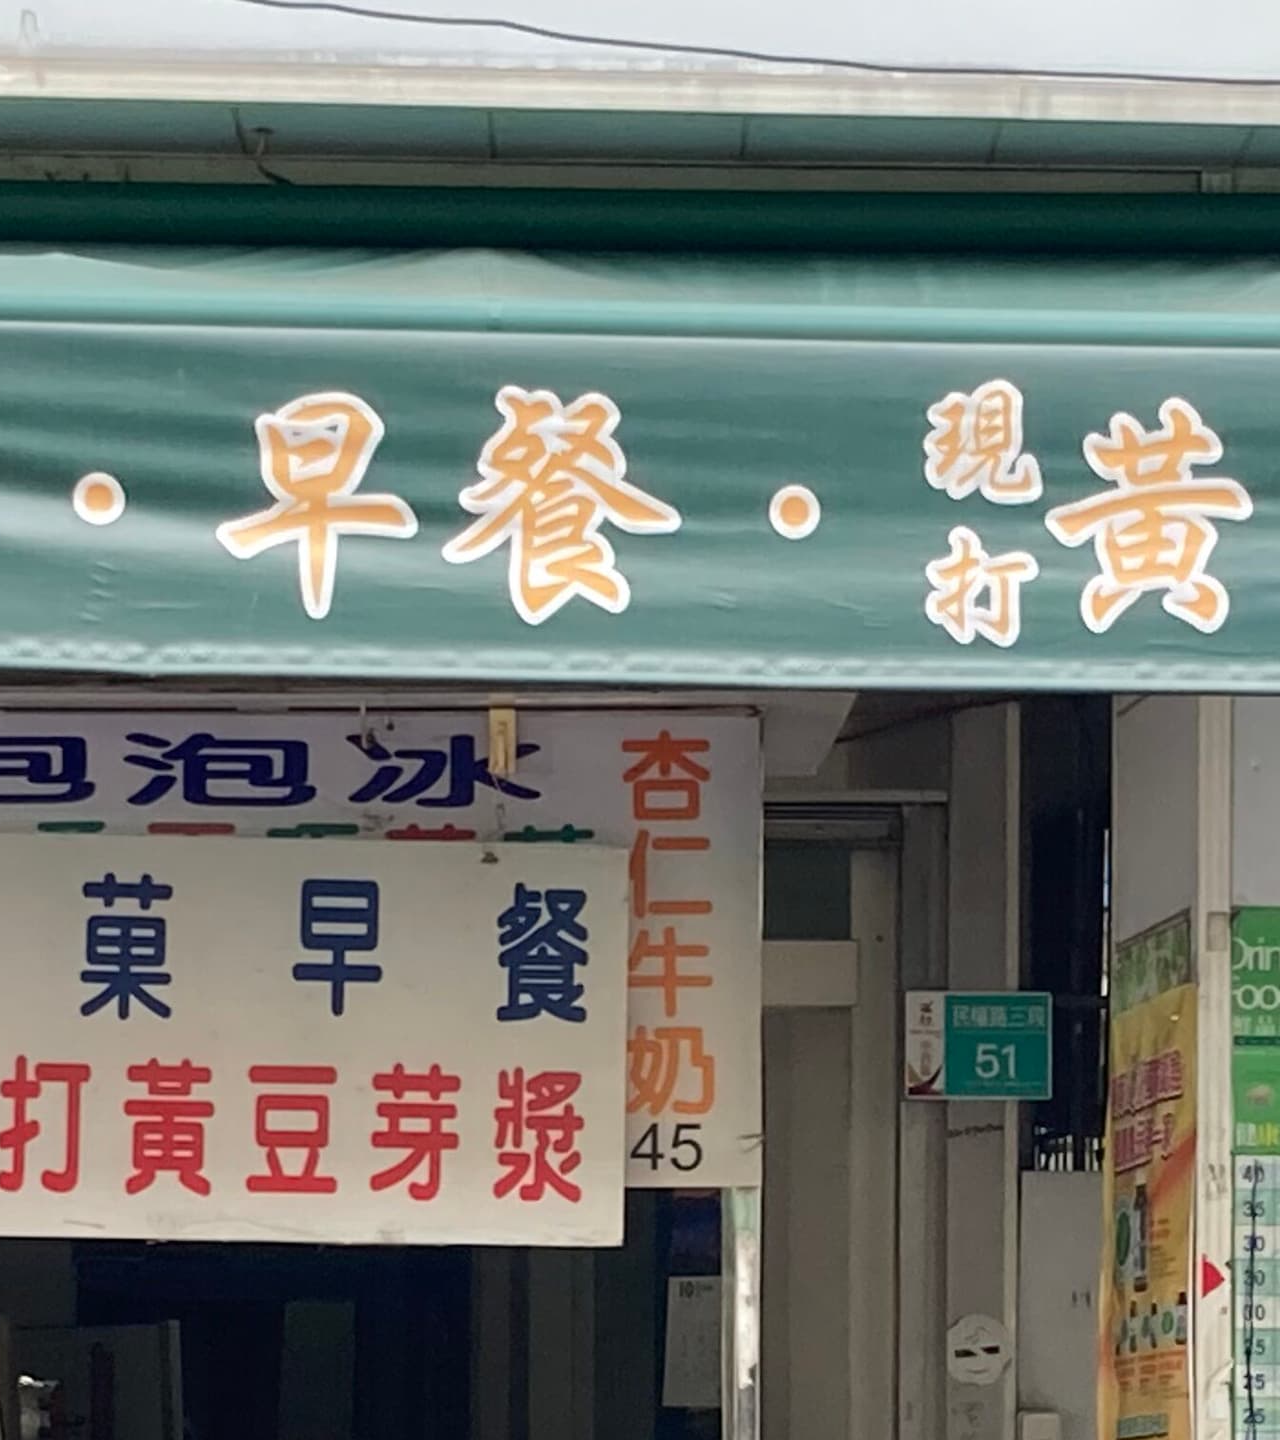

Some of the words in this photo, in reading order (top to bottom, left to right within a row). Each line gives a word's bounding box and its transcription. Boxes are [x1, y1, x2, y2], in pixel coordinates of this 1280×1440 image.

[226, 390, 672, 618] 早餐
[928, 385, 1036, 642] 現打
[626, 729, 714, 1117] 杏仁牛奶
[629, 1121, 703, 1172] 45
[975, 1043, 1017, 1079] 51
